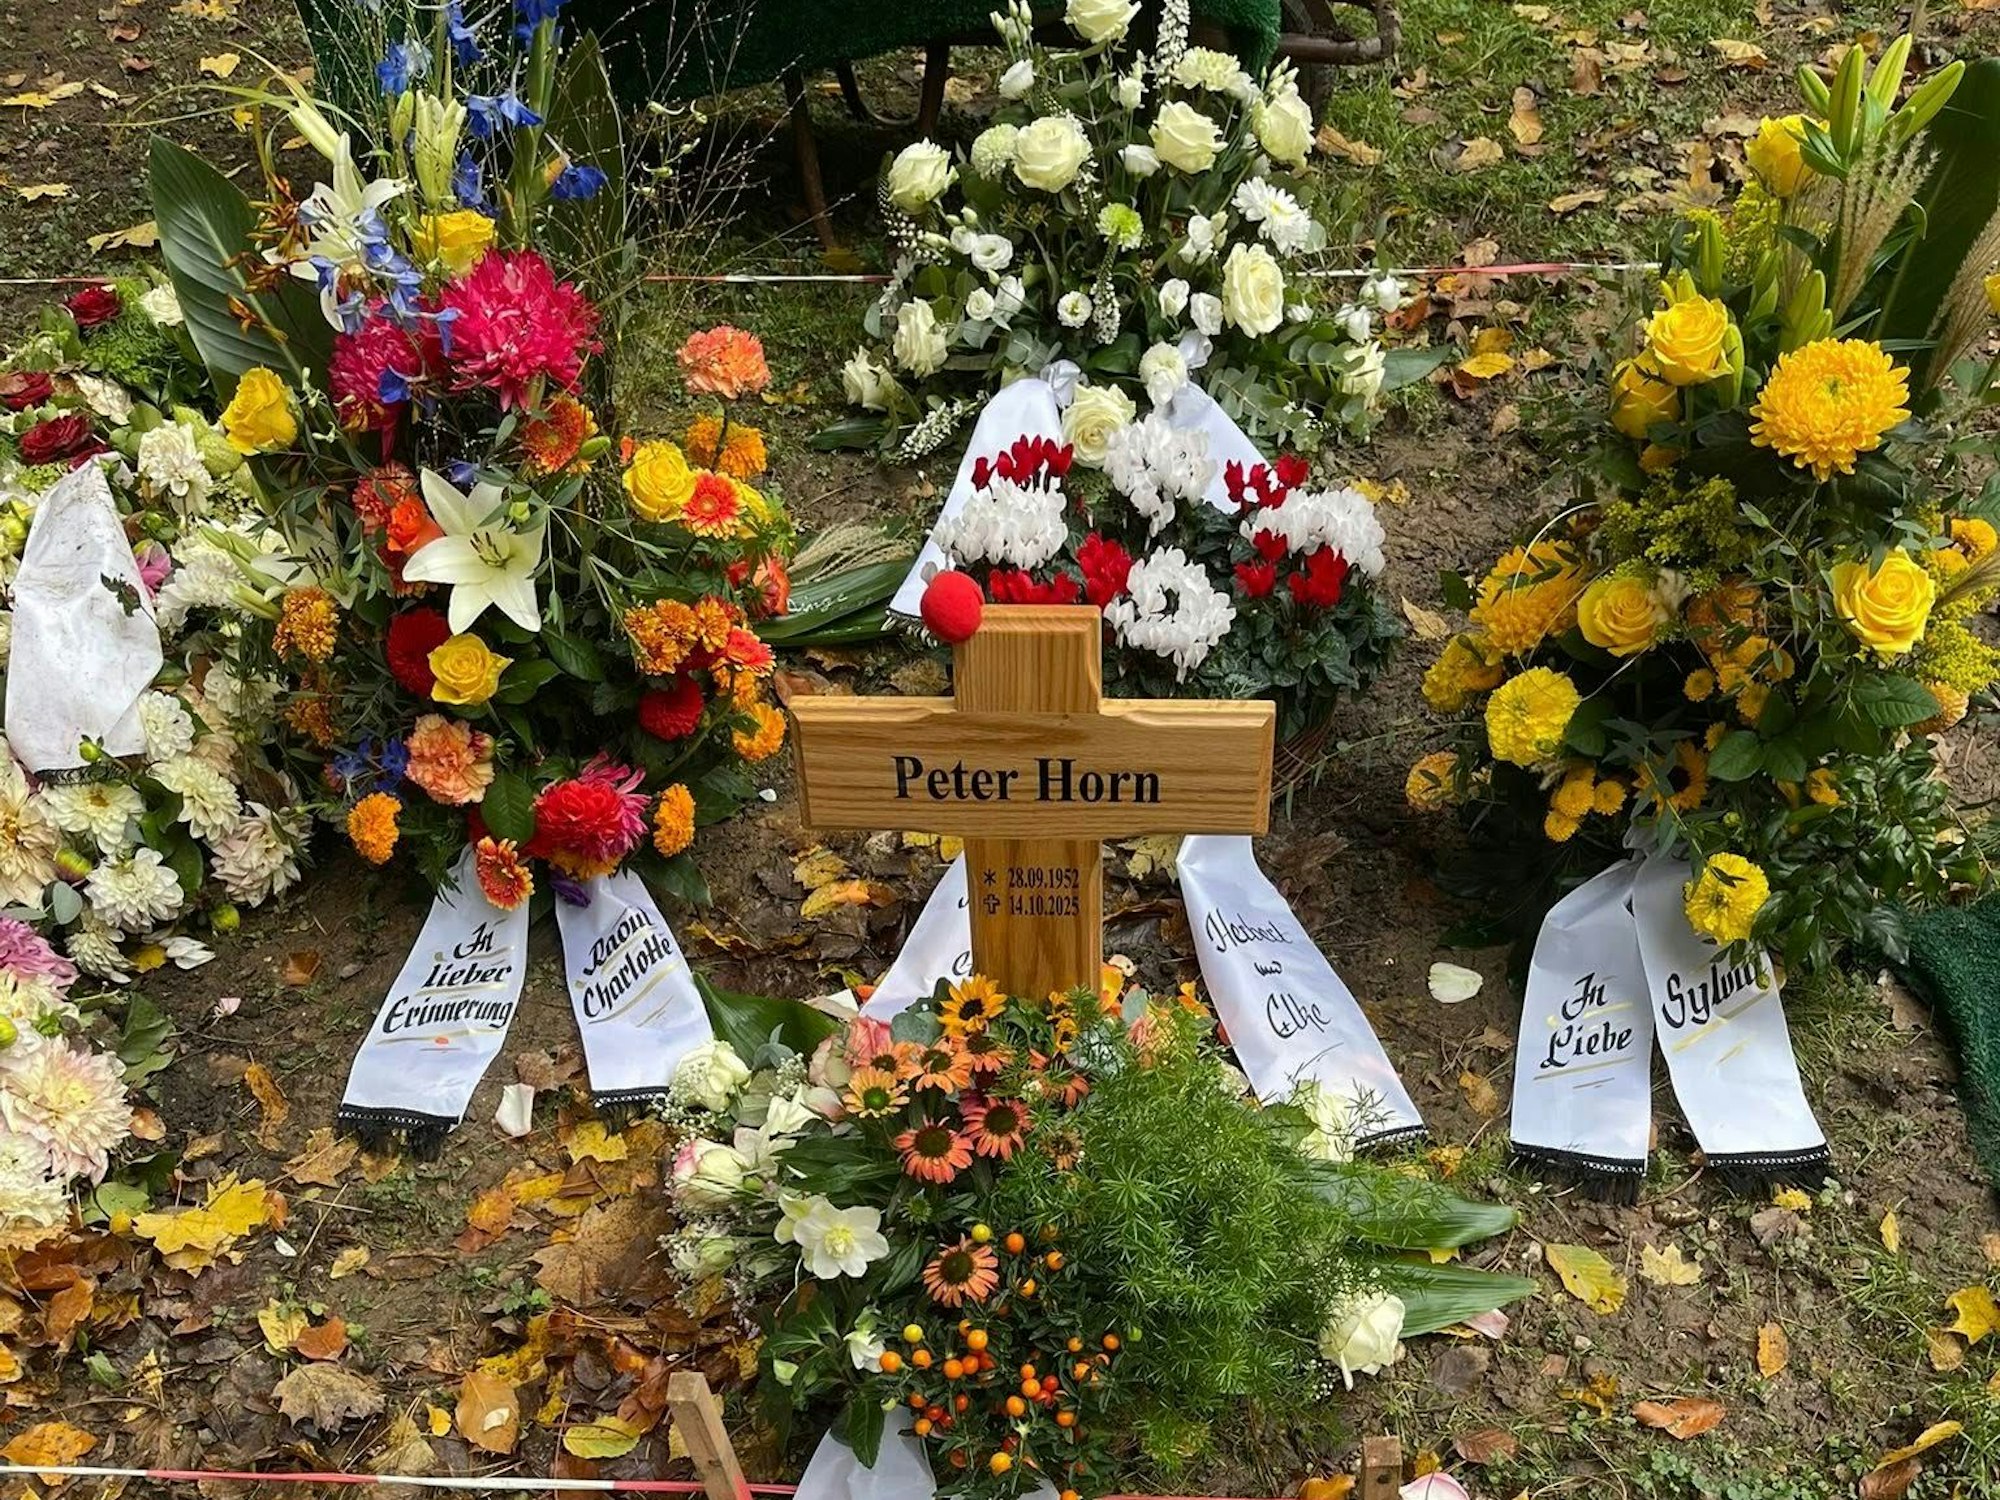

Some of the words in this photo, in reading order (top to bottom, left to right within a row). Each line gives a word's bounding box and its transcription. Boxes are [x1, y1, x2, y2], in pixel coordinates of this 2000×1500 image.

[891, 754, 1019, 801] Peter
[1034, 757, 1161, 804] Horn
[1007, 866, 1080, 890] 28.09.1952
[1008, 893, 1080, 917] 14.10.2025
[452, 921, 495, 960] In
[582, 932, 674, 1018] Charlotte
[1560, 971, 1610, 1022] In
[381, 996, 515, 1035] Erinnerung
[1539, 1020, 1636, 1070] Liebe
